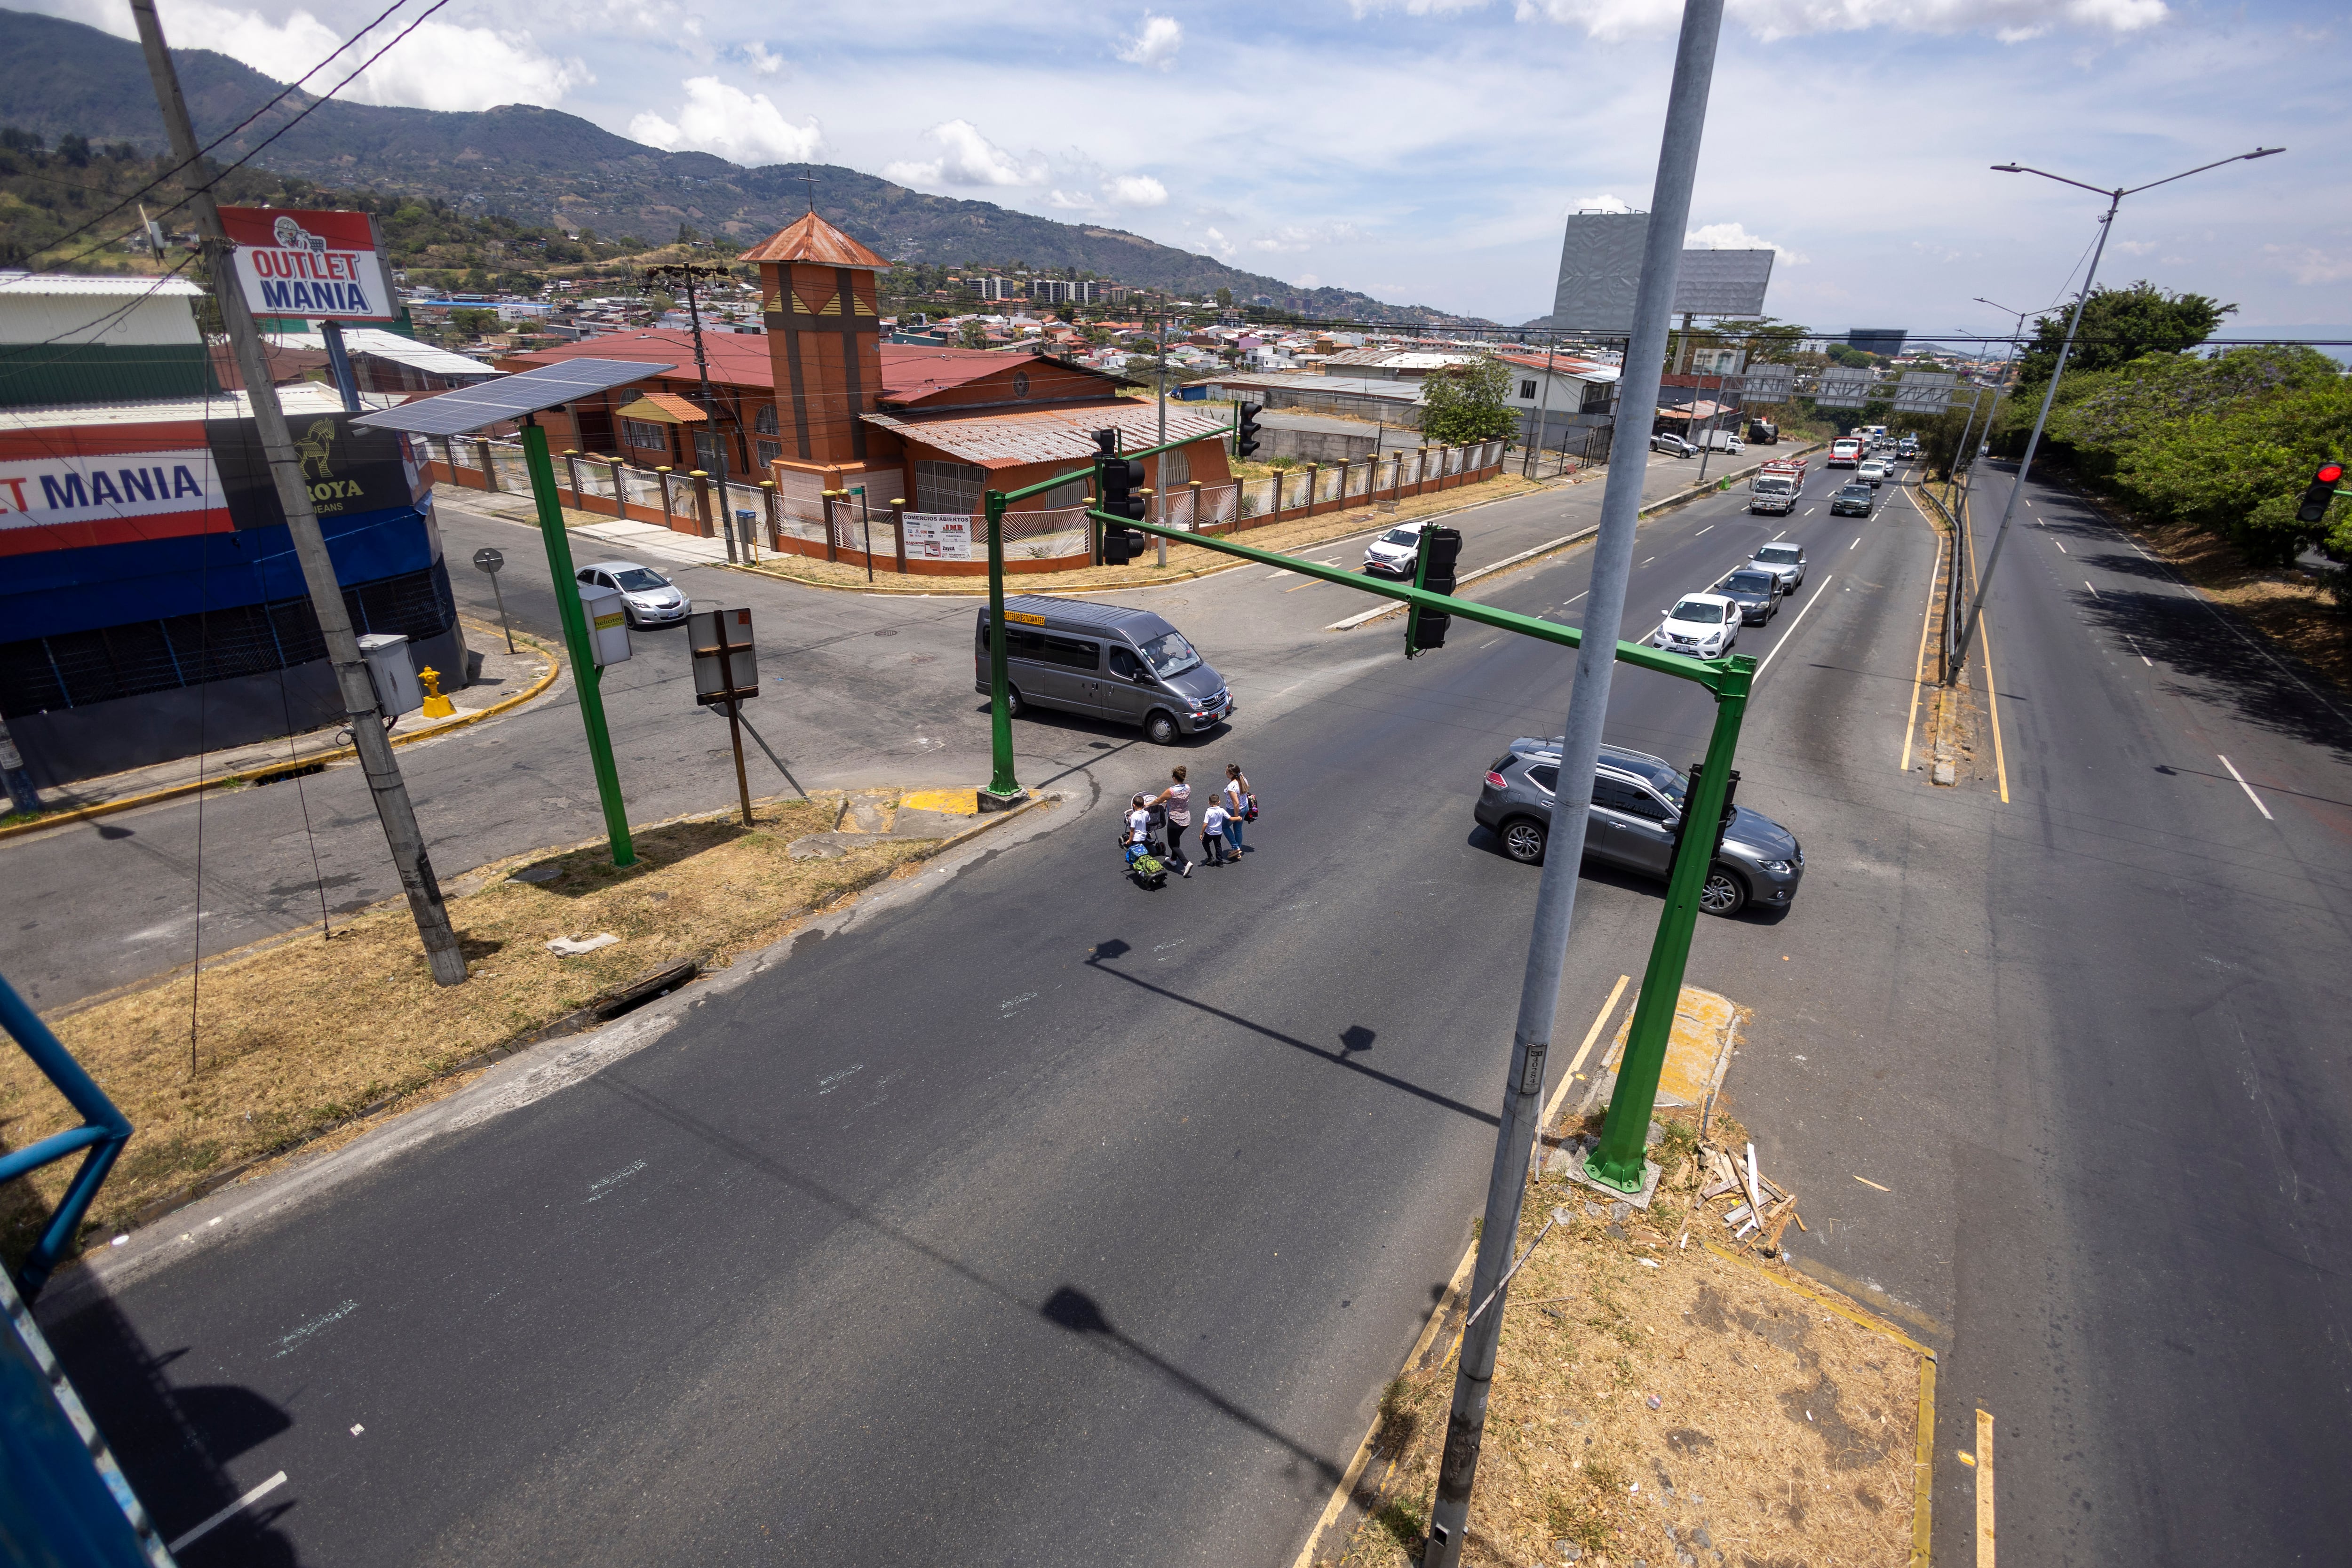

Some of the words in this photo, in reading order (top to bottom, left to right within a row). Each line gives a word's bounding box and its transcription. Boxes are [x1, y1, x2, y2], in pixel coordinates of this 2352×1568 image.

[252, 250, 357, 280] OUTLET
[260, 280, 368, 310] MANIA
[39, 465, 204, 509] MANIA
[306, 480, 365, 501] ROYA
[313, 502, 343, 514] JEANS
[595, 616, 624, 627] heliotek
[1004, 611, 1014, 621] ORTE
[1015, 613, 1020, 621] DE
[1021, 613, 1045, 625] ESTUDIANTES
